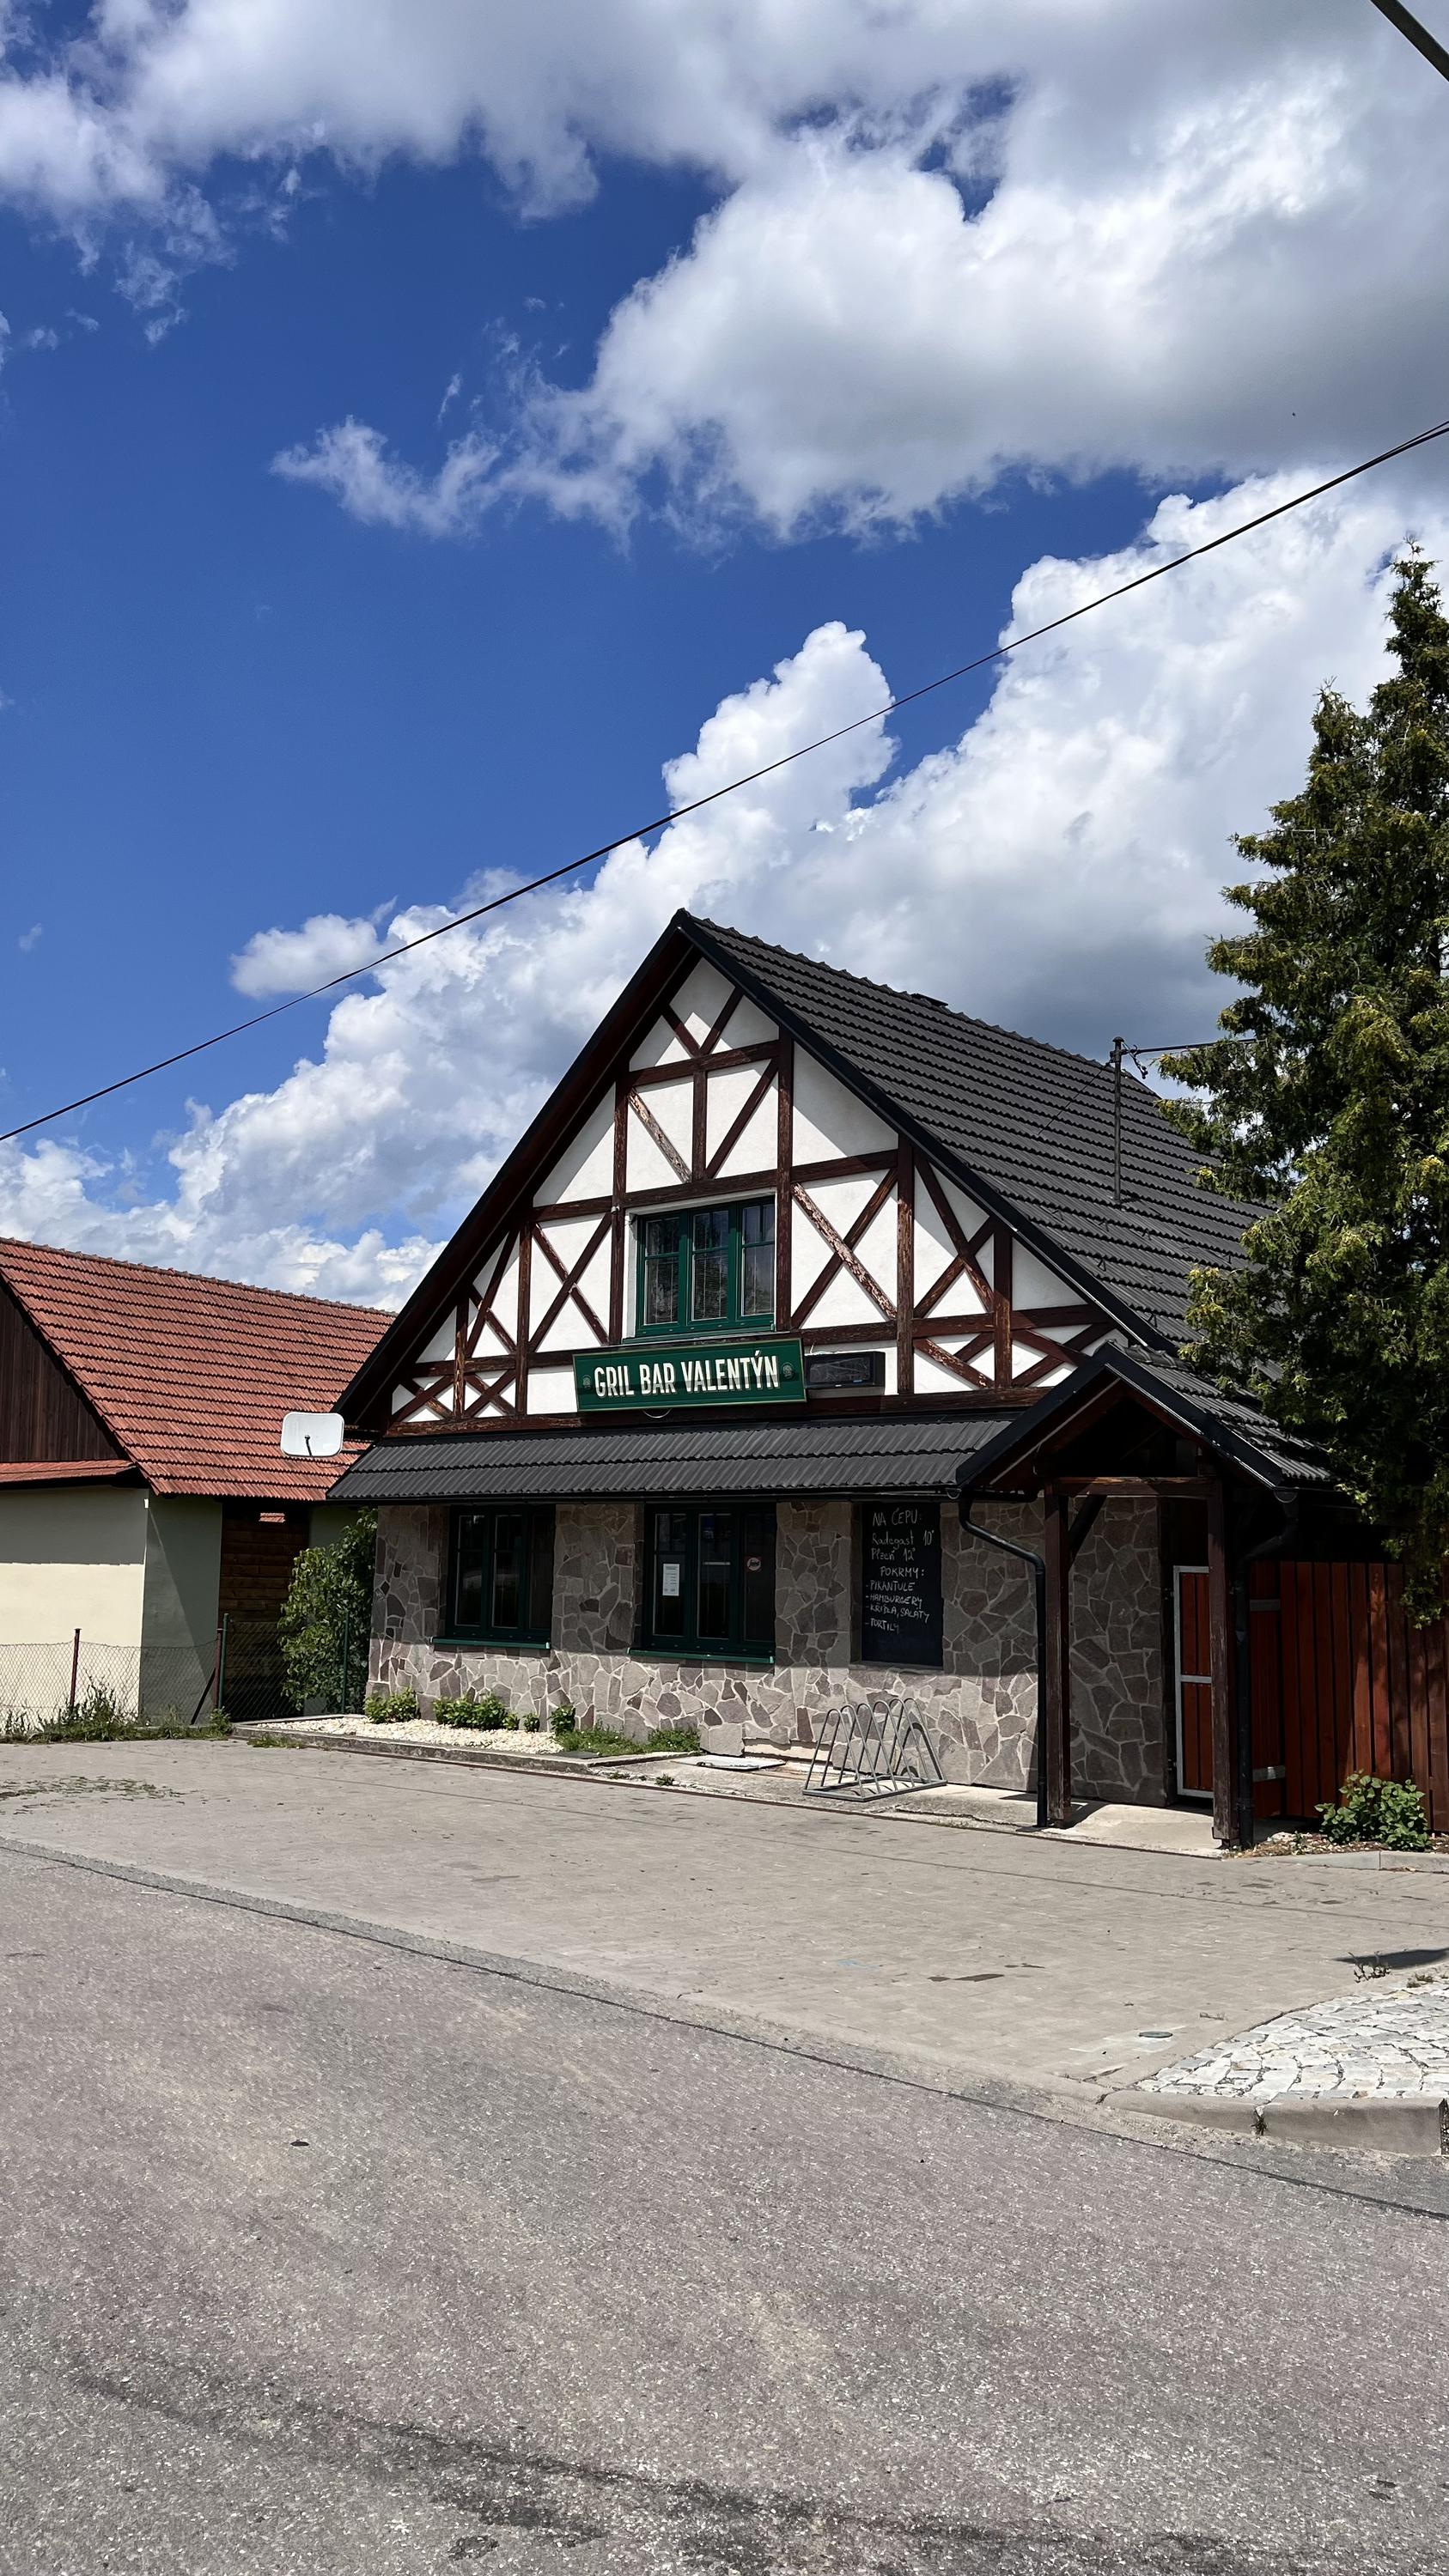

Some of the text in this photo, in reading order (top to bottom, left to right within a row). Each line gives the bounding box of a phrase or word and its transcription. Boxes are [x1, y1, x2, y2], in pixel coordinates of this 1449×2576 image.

[594, 1350, 780, 1397] GRIL BAR VALENTÝN
[872, 1511, 887, 1527] NA
[872, 1528, 914, 1550] Radegast
